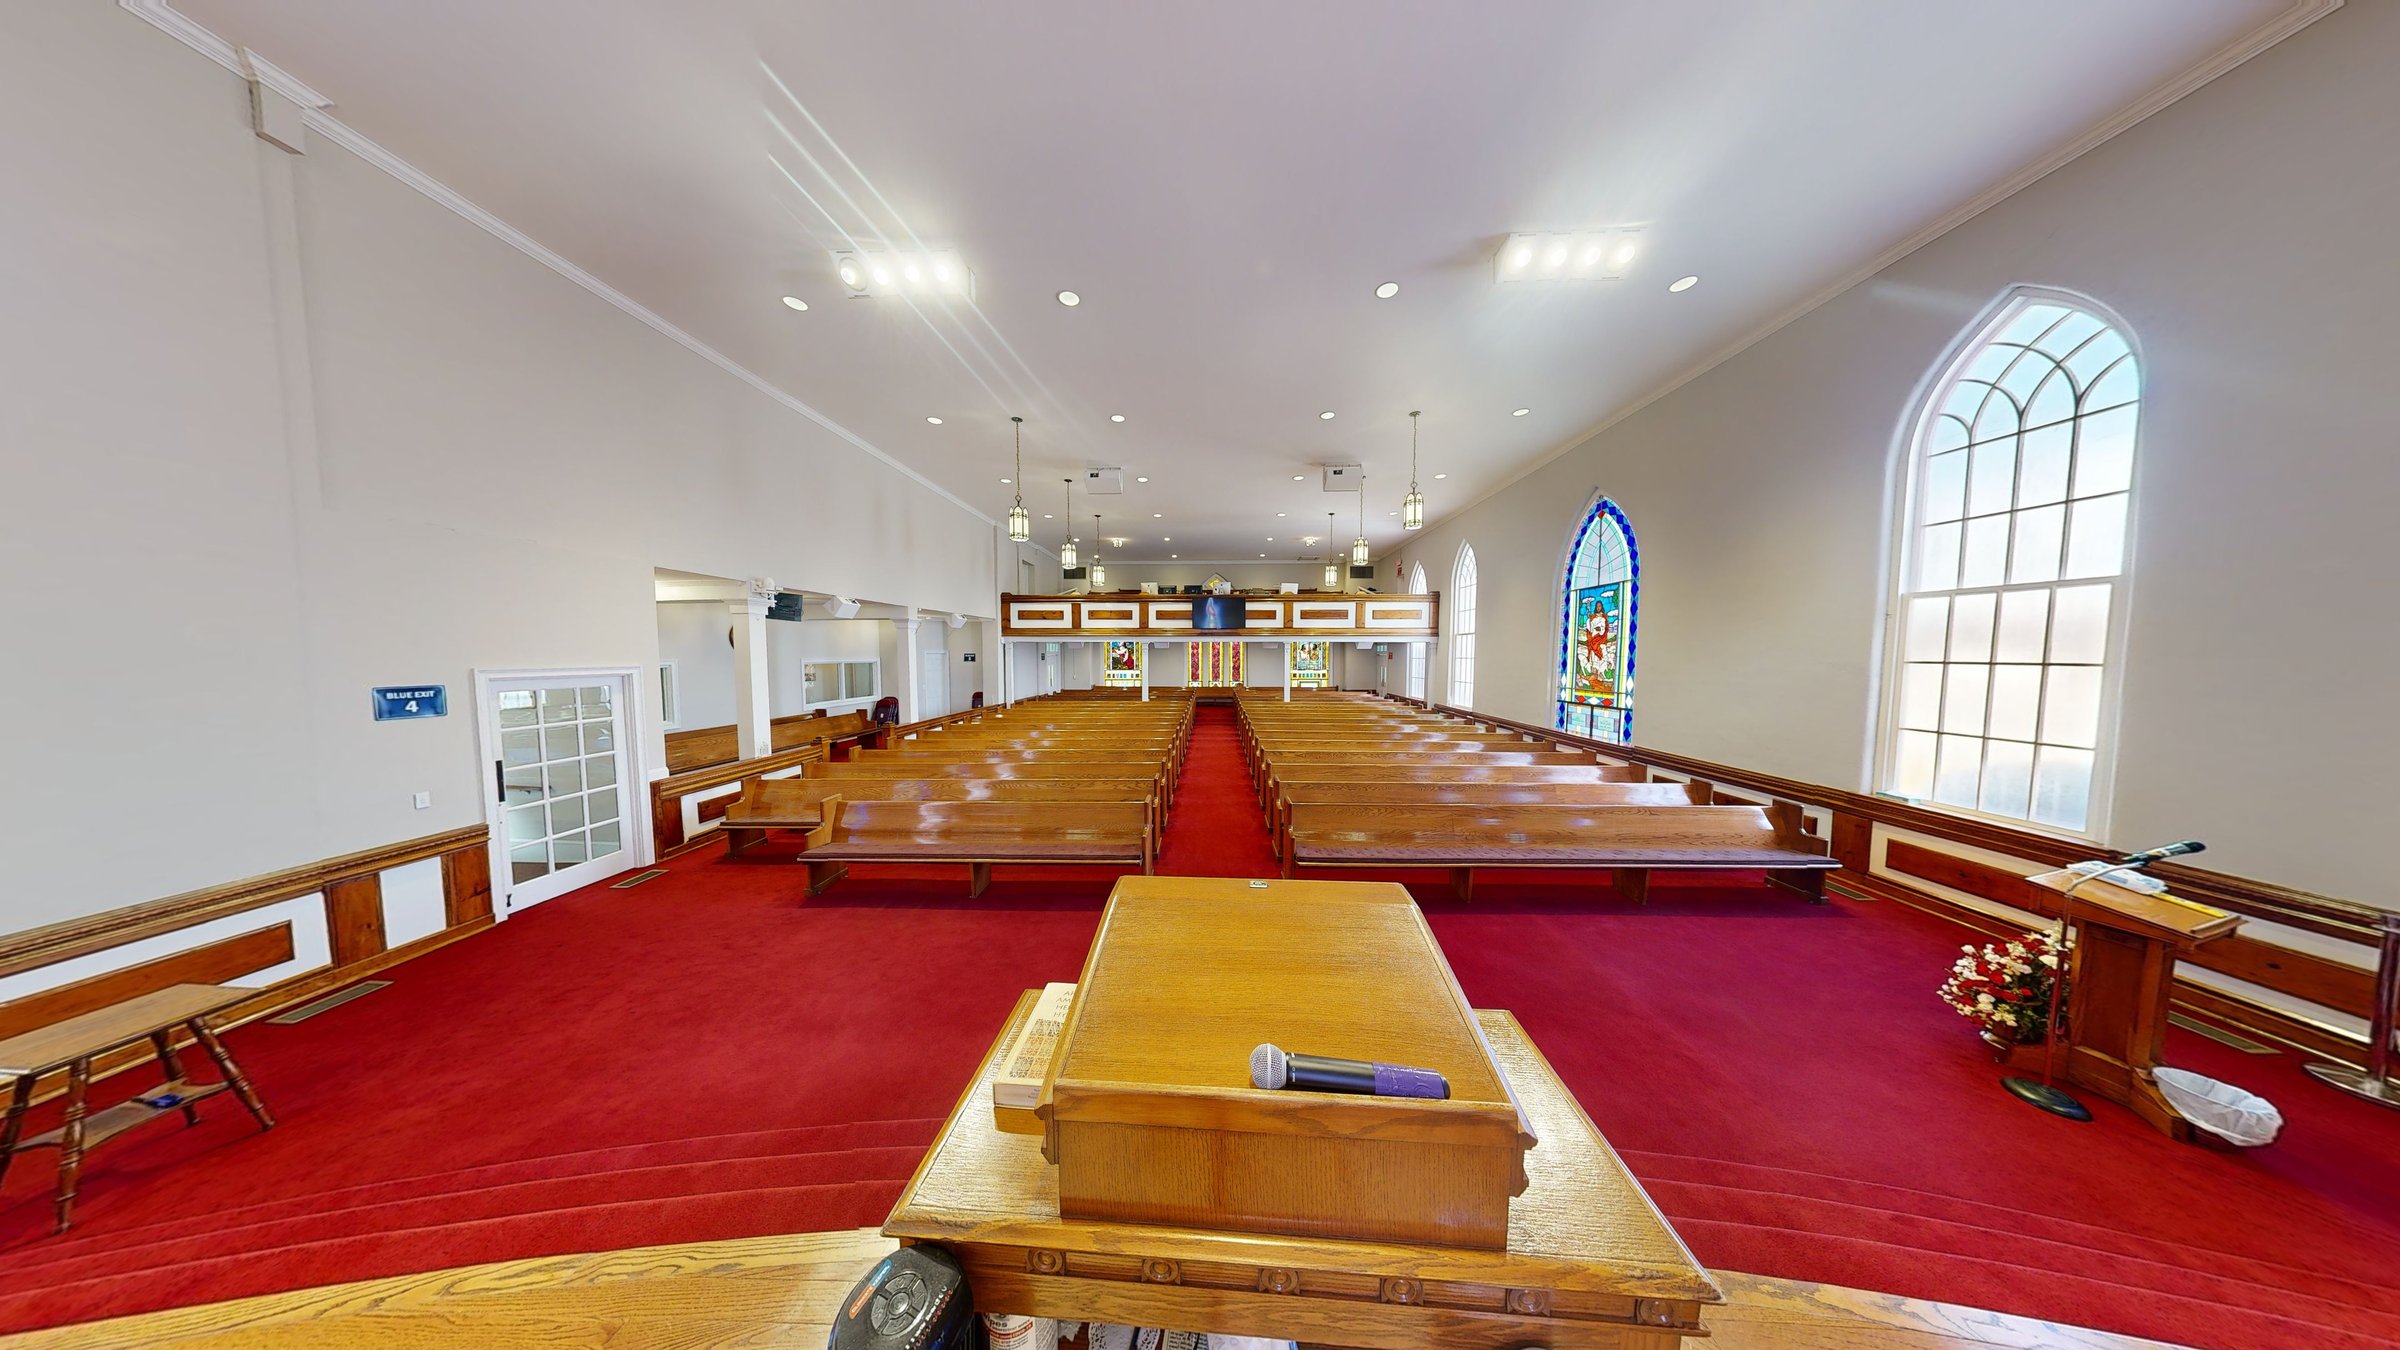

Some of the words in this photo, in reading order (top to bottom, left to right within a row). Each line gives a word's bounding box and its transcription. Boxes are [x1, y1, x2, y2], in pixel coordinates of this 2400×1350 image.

[386, 691, 413, 700] BLUE
[414, 690, 436, 698] EXIT
[405, 700, 419, 713] 4
